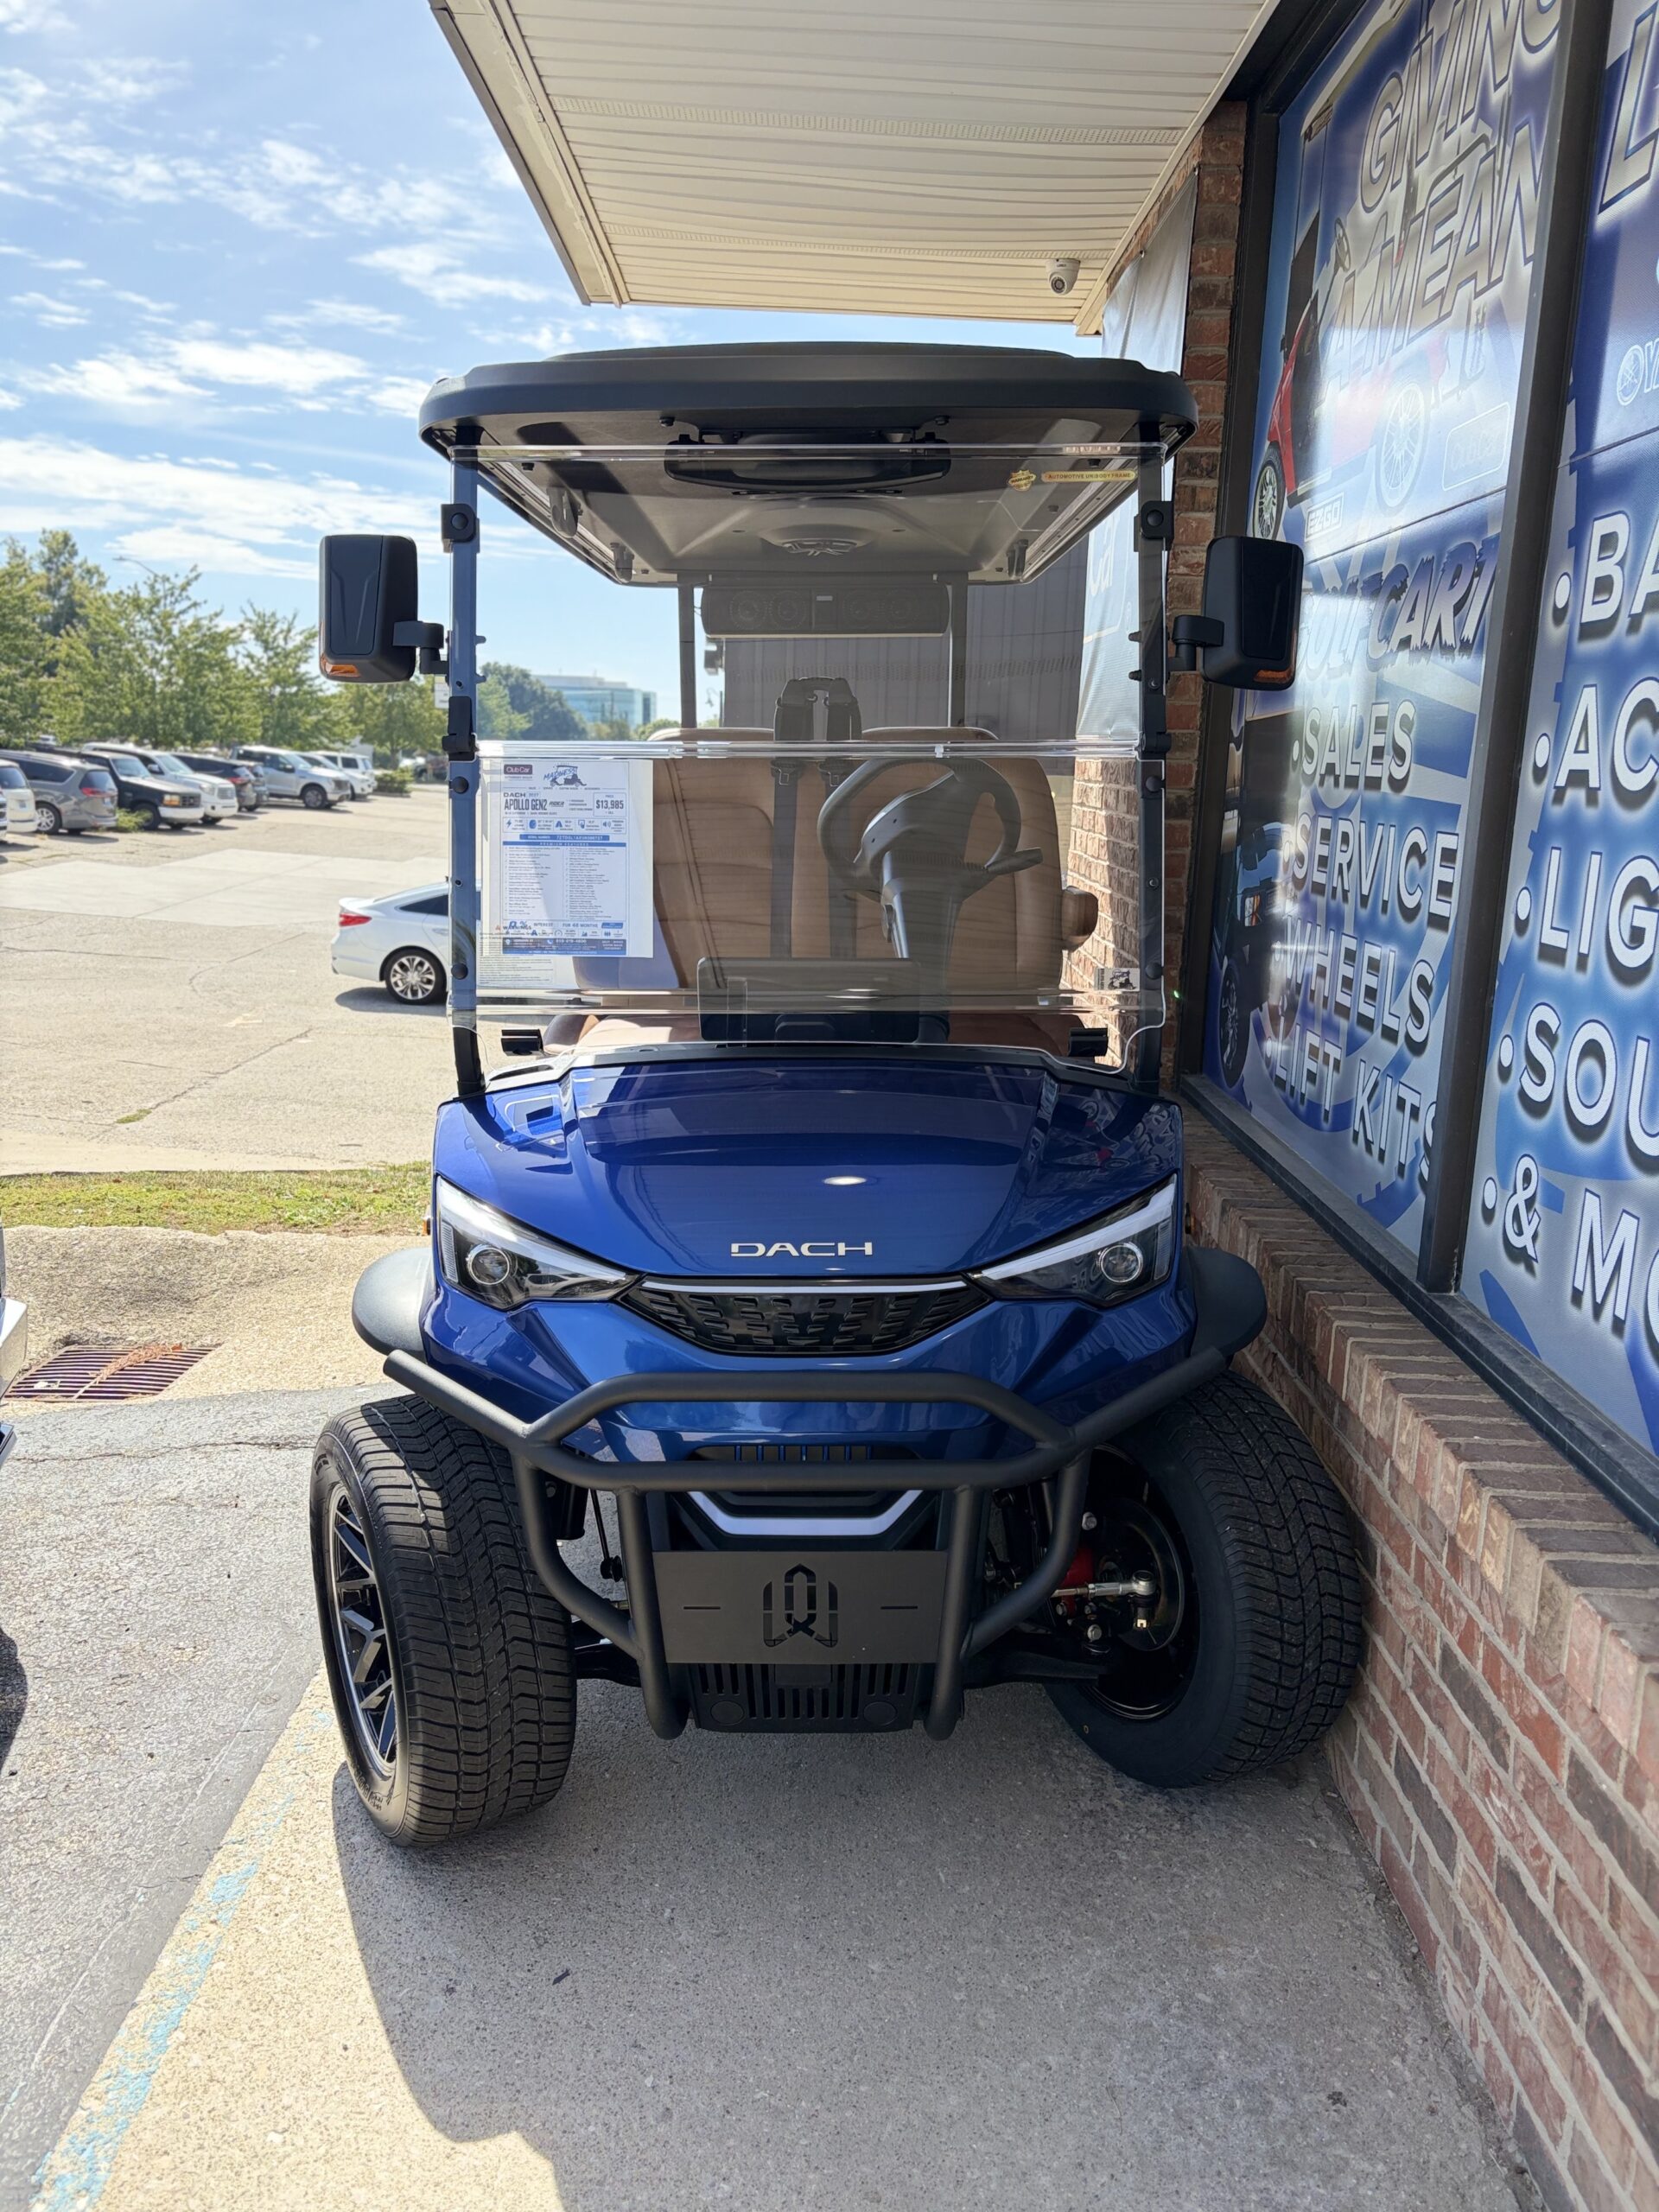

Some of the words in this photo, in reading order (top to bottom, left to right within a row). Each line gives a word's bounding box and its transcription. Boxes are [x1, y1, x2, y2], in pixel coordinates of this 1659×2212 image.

[1301, 698, 1416, 780] SALES
[504, 798, 529, 810] APOLLO
[531, 799, 548, 810] GEN2
[595, 799, 624, 810] $13,985
[1293, 812, 1459, 918] SERVICE
[1541, 846, 1659, 969] LIG
[1286, 915, 1435, 1044] WHEELS
[1274, 1016, 1342, 1115] LIFT
[731, 1242, 873, 1257] DACH
[1504, 1154, 1541, 1262] &
[1573, 1187, 1659, 1346] M
